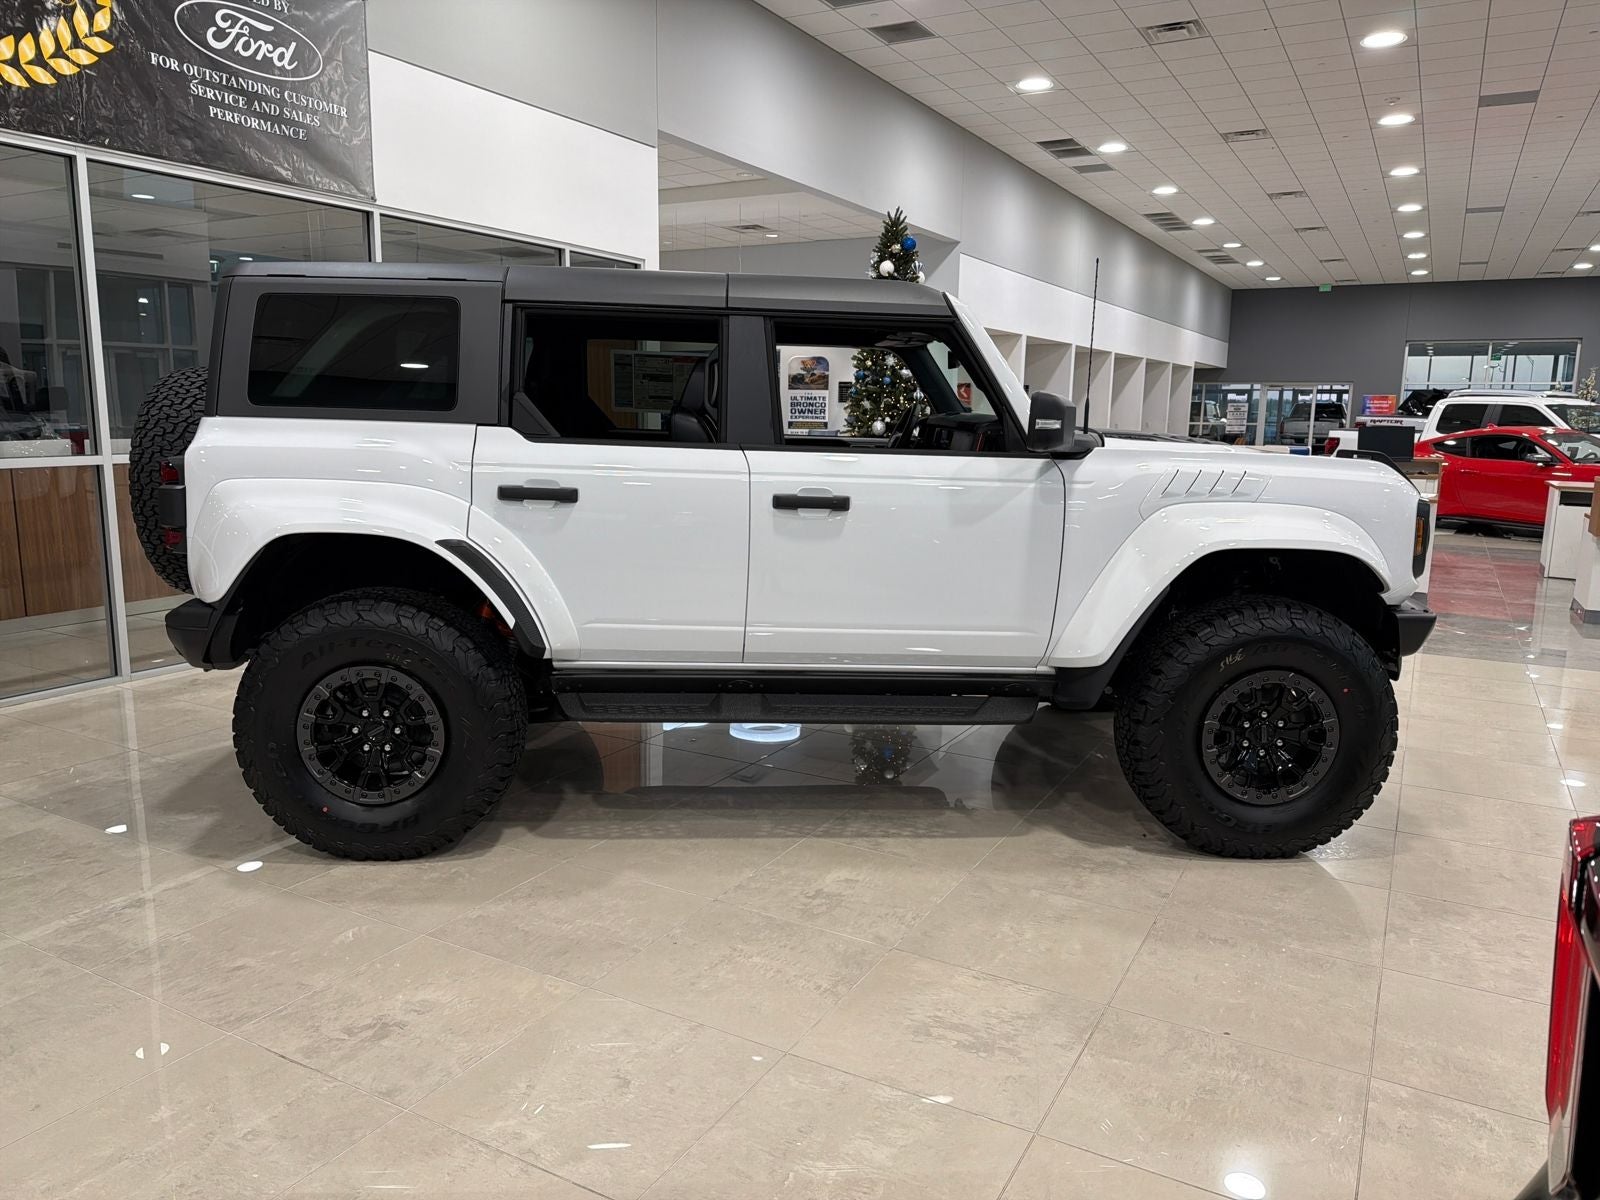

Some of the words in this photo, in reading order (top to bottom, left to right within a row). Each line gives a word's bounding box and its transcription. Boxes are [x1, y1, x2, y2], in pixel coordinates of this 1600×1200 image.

[274, 0, 290, 15] BY
[206, 9, 298, 70] Ford
[149, 51, 181, 72] FOR
[183, 62, 281, 99] OUTSTANDING
[284, 90, 348, 118] CUSTOMER
[190, 82, 248, 109] SERVICE
[251, 100, 280, 116] AND
[283, 107, 321, 127] SALES
[208, 105, 308, 141] PERFORMANCE
